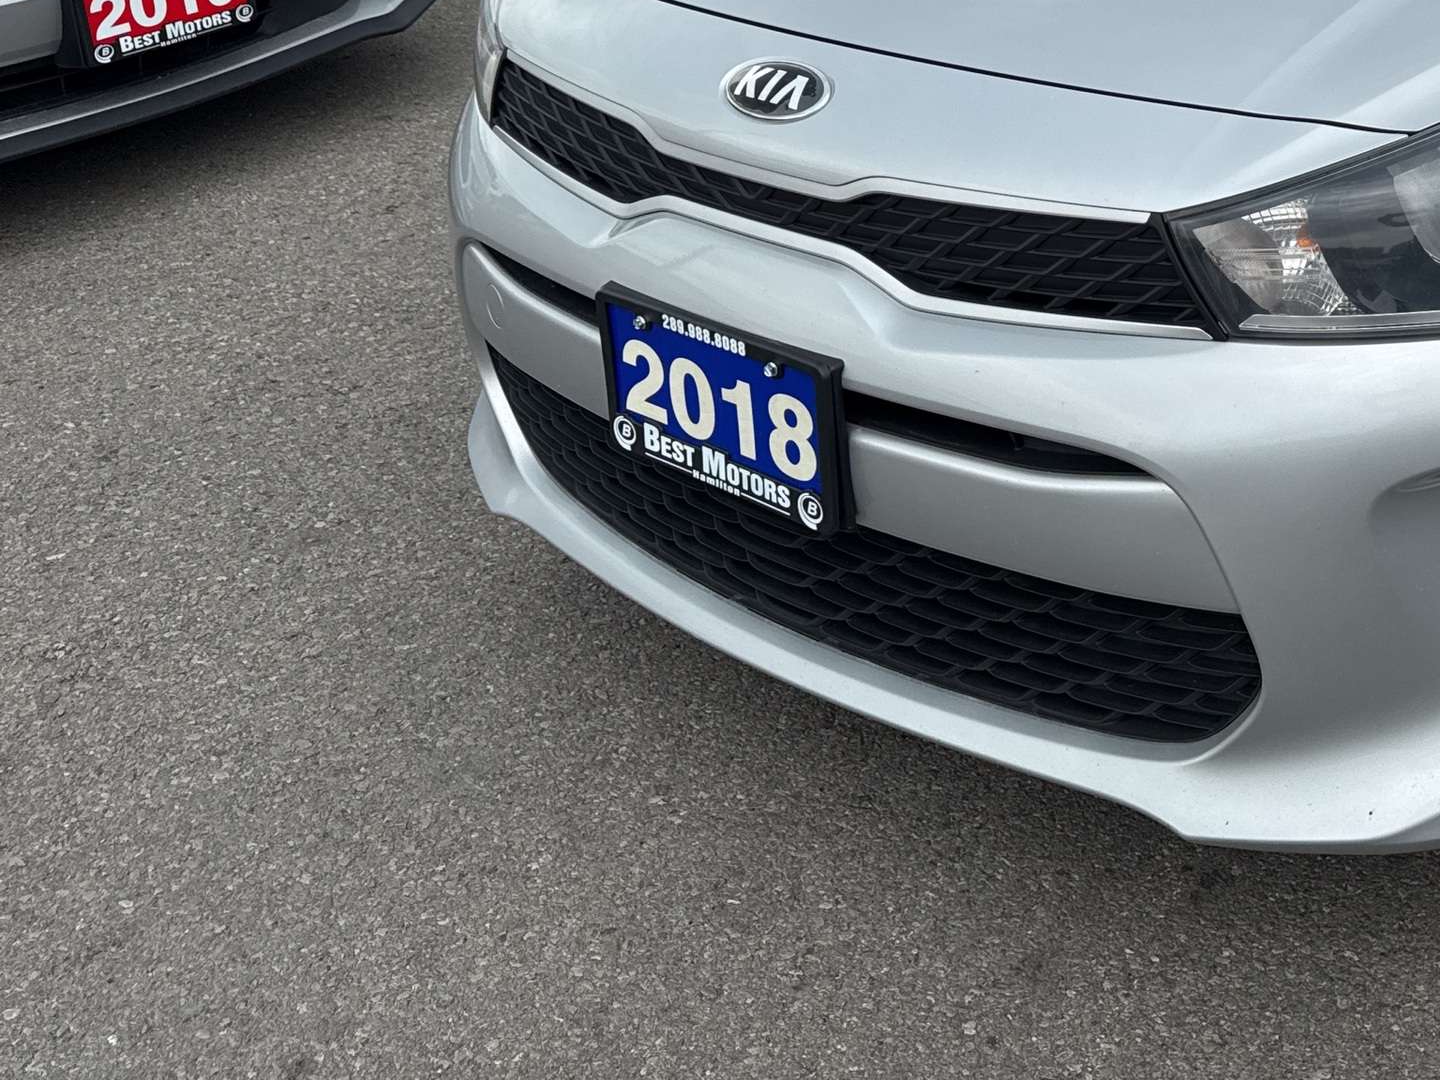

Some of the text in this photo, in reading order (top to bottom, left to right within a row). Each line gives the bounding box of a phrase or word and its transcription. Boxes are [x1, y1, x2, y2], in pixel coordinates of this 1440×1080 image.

[118, 10, 232, 53] BEST MOTORS
[733, 64, 809, 111] KIA
[661, 313, 746, 357] 289.988.8088
[622, 338, 817, 482] 2018
[643, 422, 791, 509] BEST MOTORS
[692, 469, 741, 497] Hamilton
